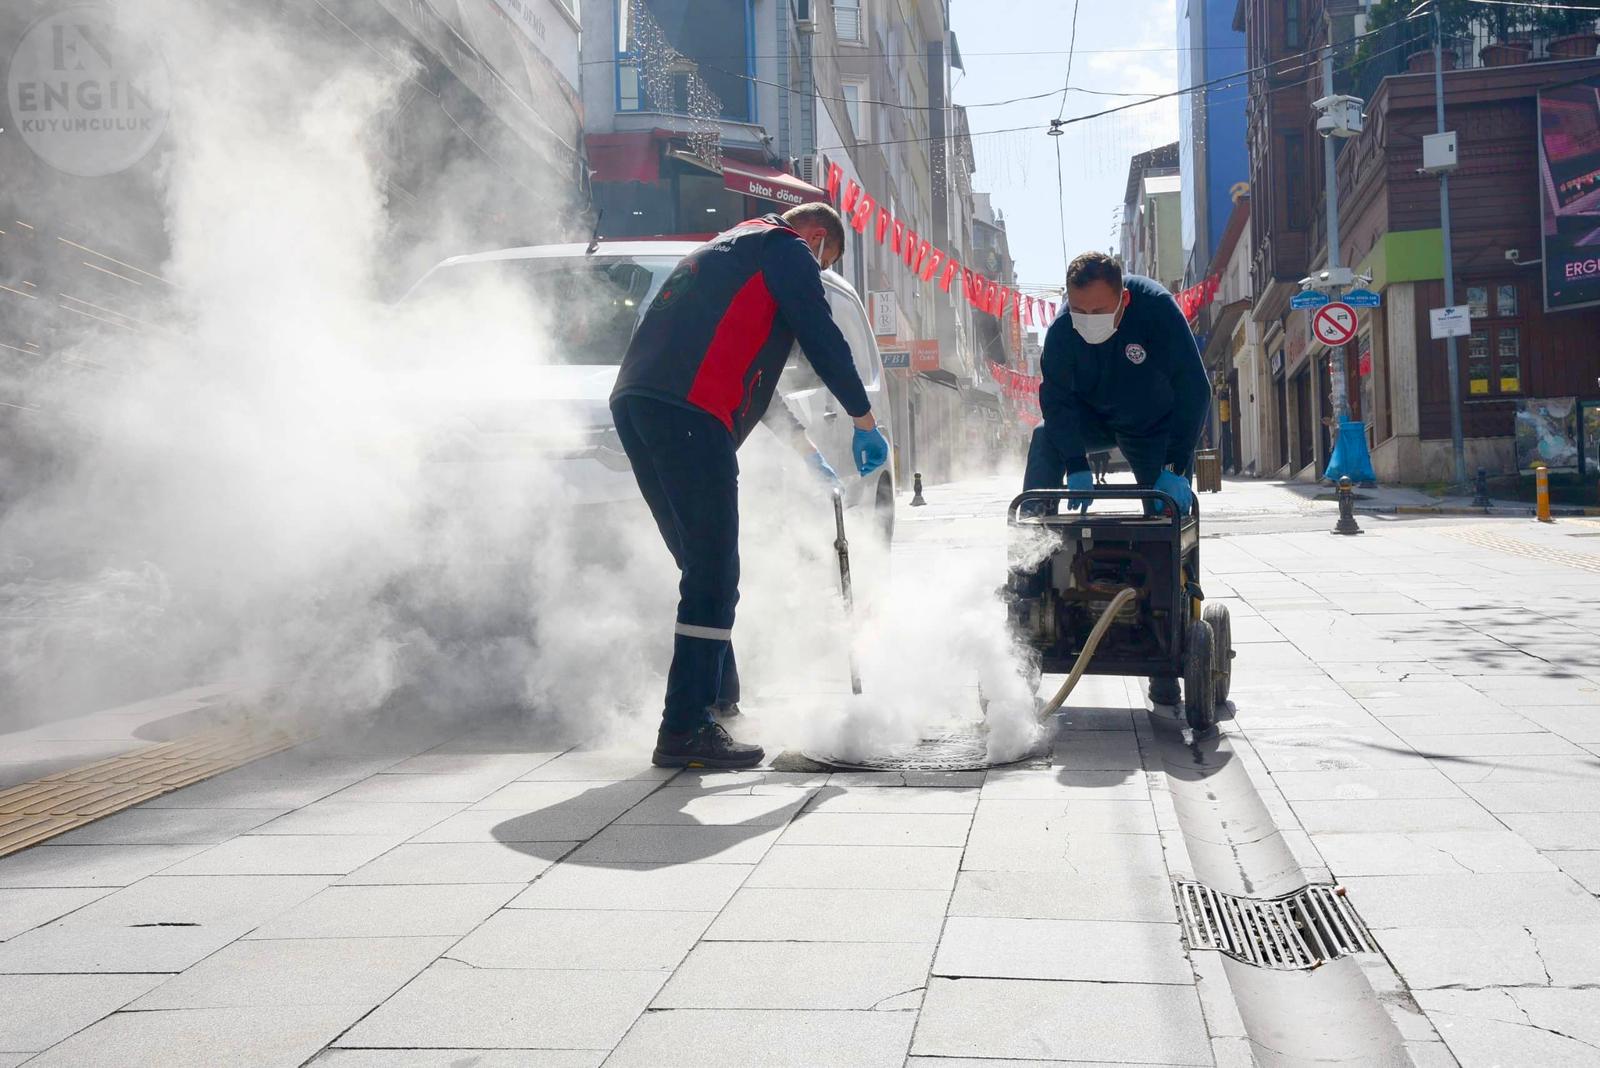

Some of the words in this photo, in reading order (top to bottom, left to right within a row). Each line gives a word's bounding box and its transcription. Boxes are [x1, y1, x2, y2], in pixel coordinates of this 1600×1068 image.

[22, 118, 151, 133] KUYUMCULUK
[749, 181, 772, 197] bitat
[777, 190, 803, 204] döner
[884, 354, 906, 364] FBI
